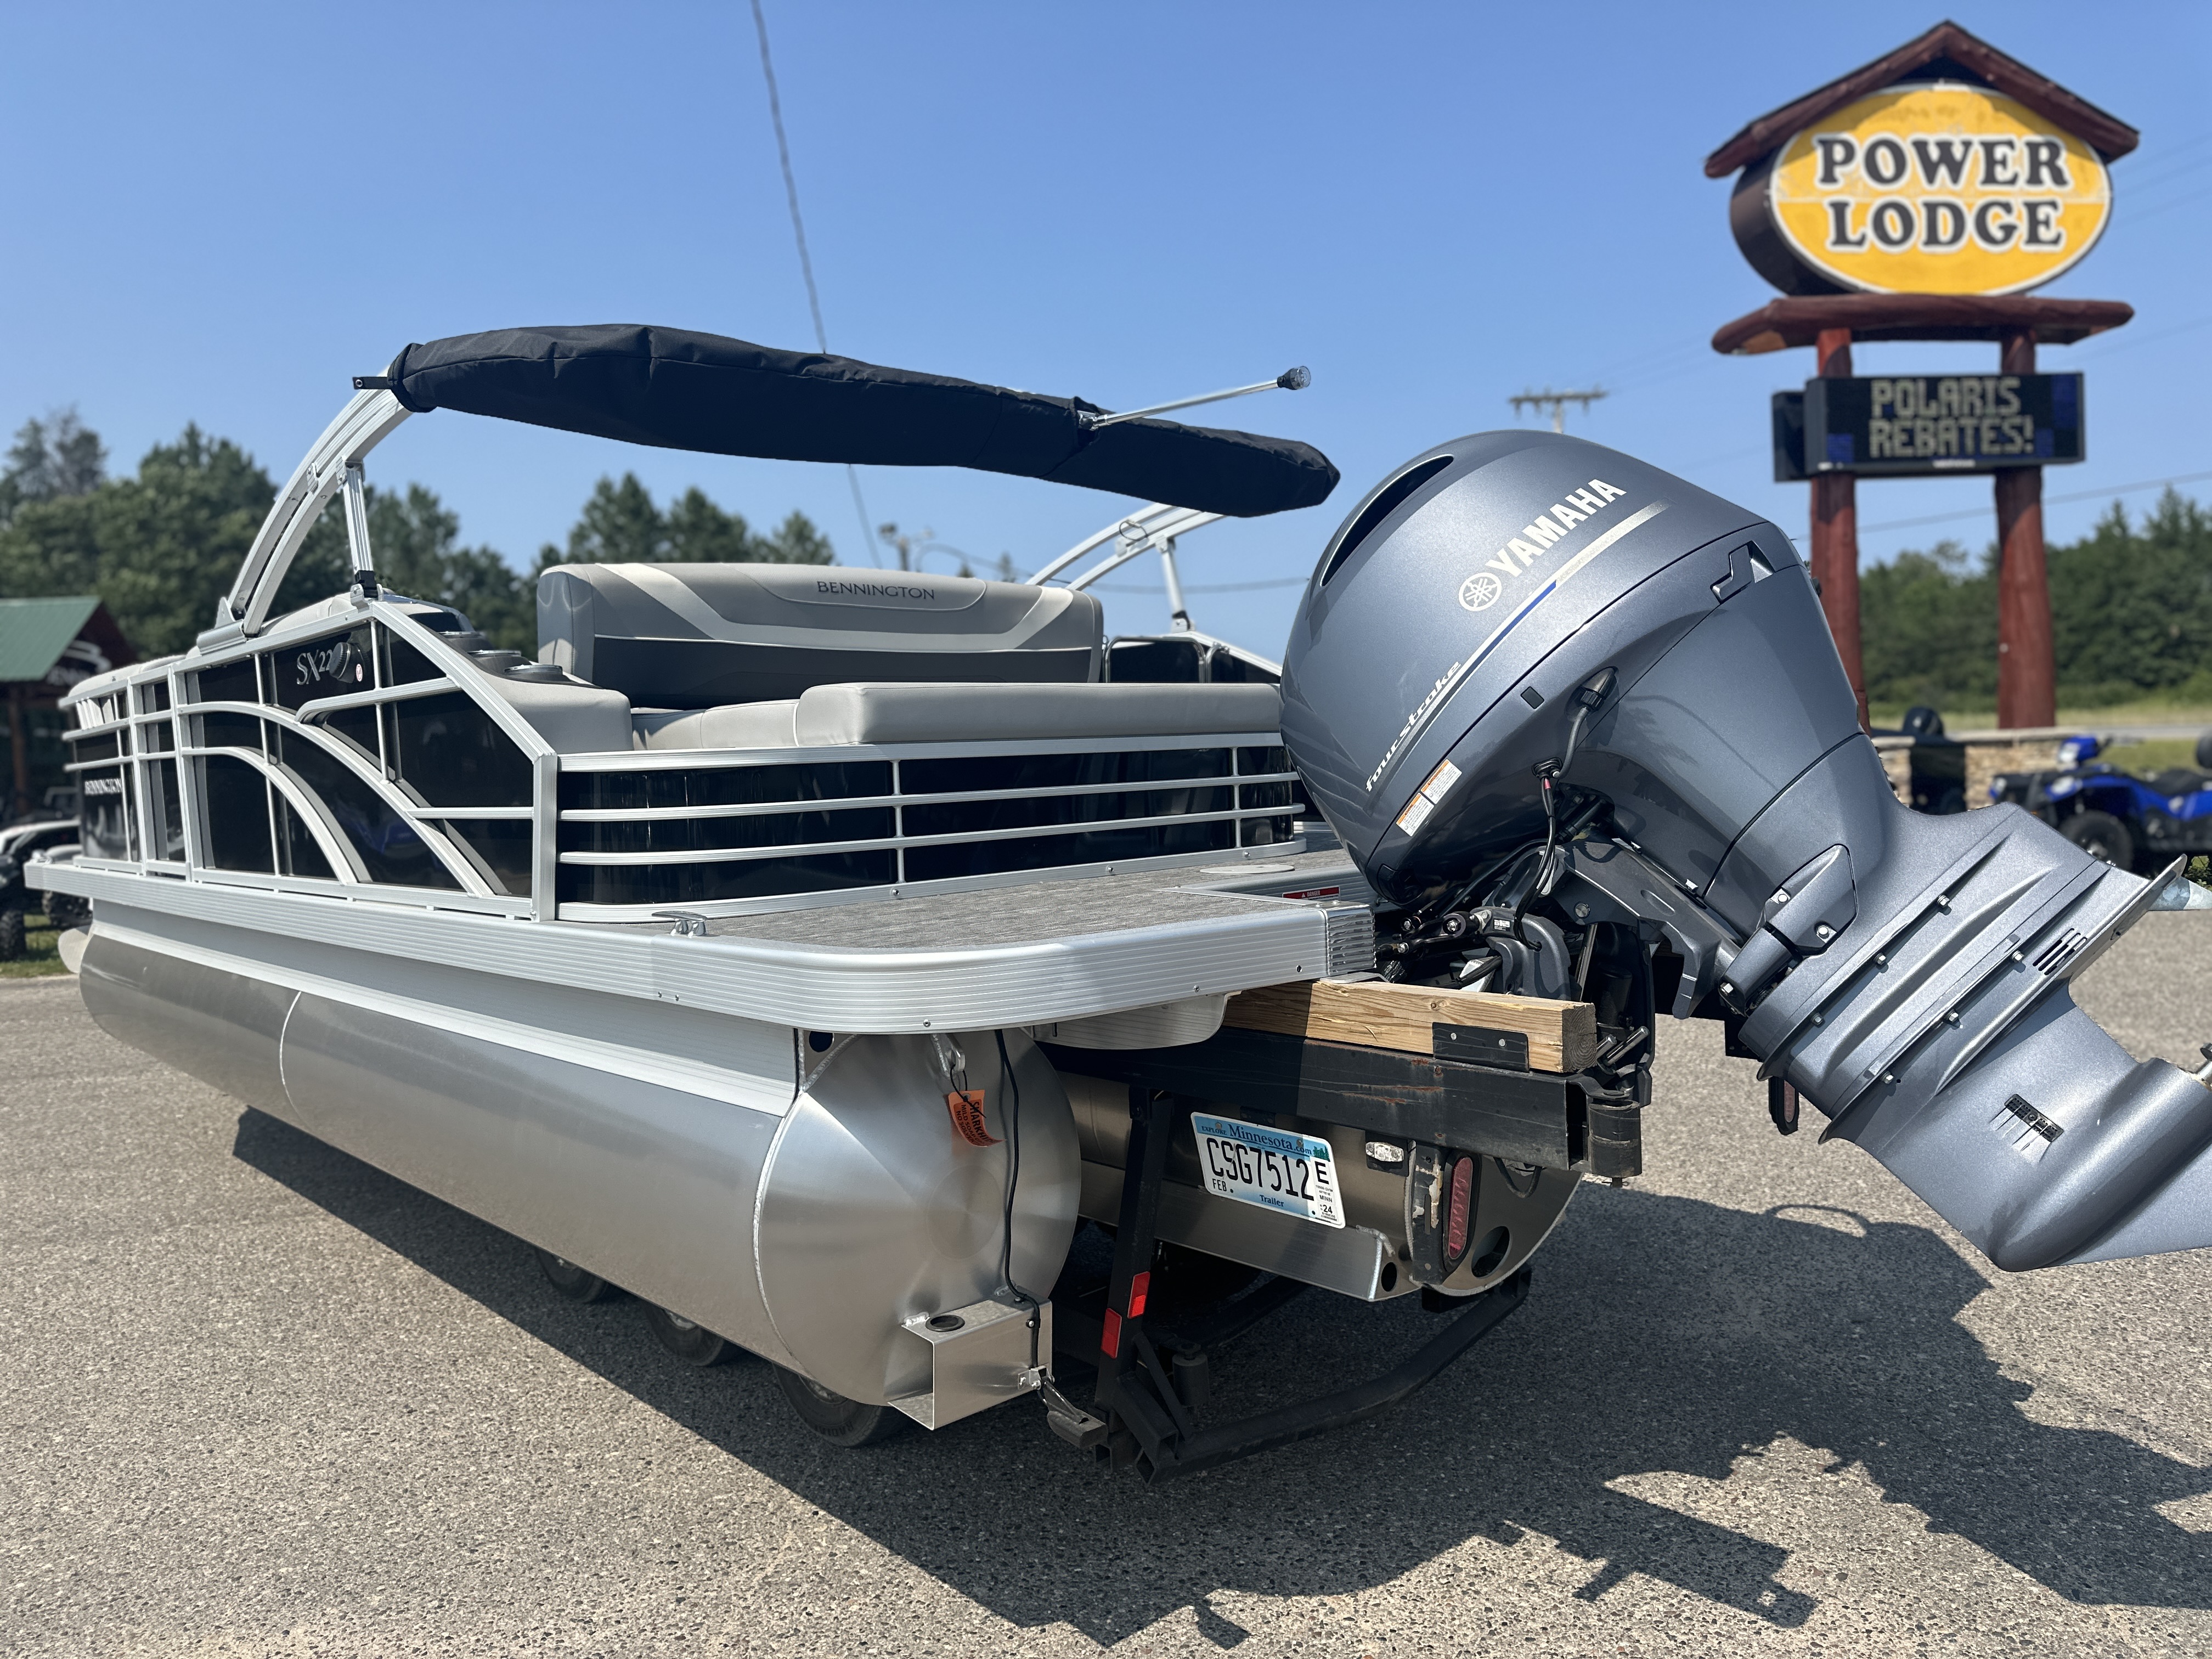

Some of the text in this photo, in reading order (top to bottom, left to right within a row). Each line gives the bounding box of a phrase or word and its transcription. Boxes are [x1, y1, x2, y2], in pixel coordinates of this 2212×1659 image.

[1816, 137, 2069, 188] POWER
[1827, 199, 2063, 247] LODGE
[1871, 377, 2021, 418] POLARIS
[1869, 415, 2034, 458] REBATES!
[1485, 479, 1627, 577] YAMAHA
[817, 581, 935, 600] BENNINGTON
[956, 1110, 963, 1121] NO
[1201, 1124, 1312, 1155] EXPLORE Minnesota.com
[1206, 1137, 1329, 1201] CSG7512 E
[1212, 1178, 1227, 1192] FEB
[1259, 1194, 1284, 1207] Trailer
[1323, 1204, 1333, 1214] 24
